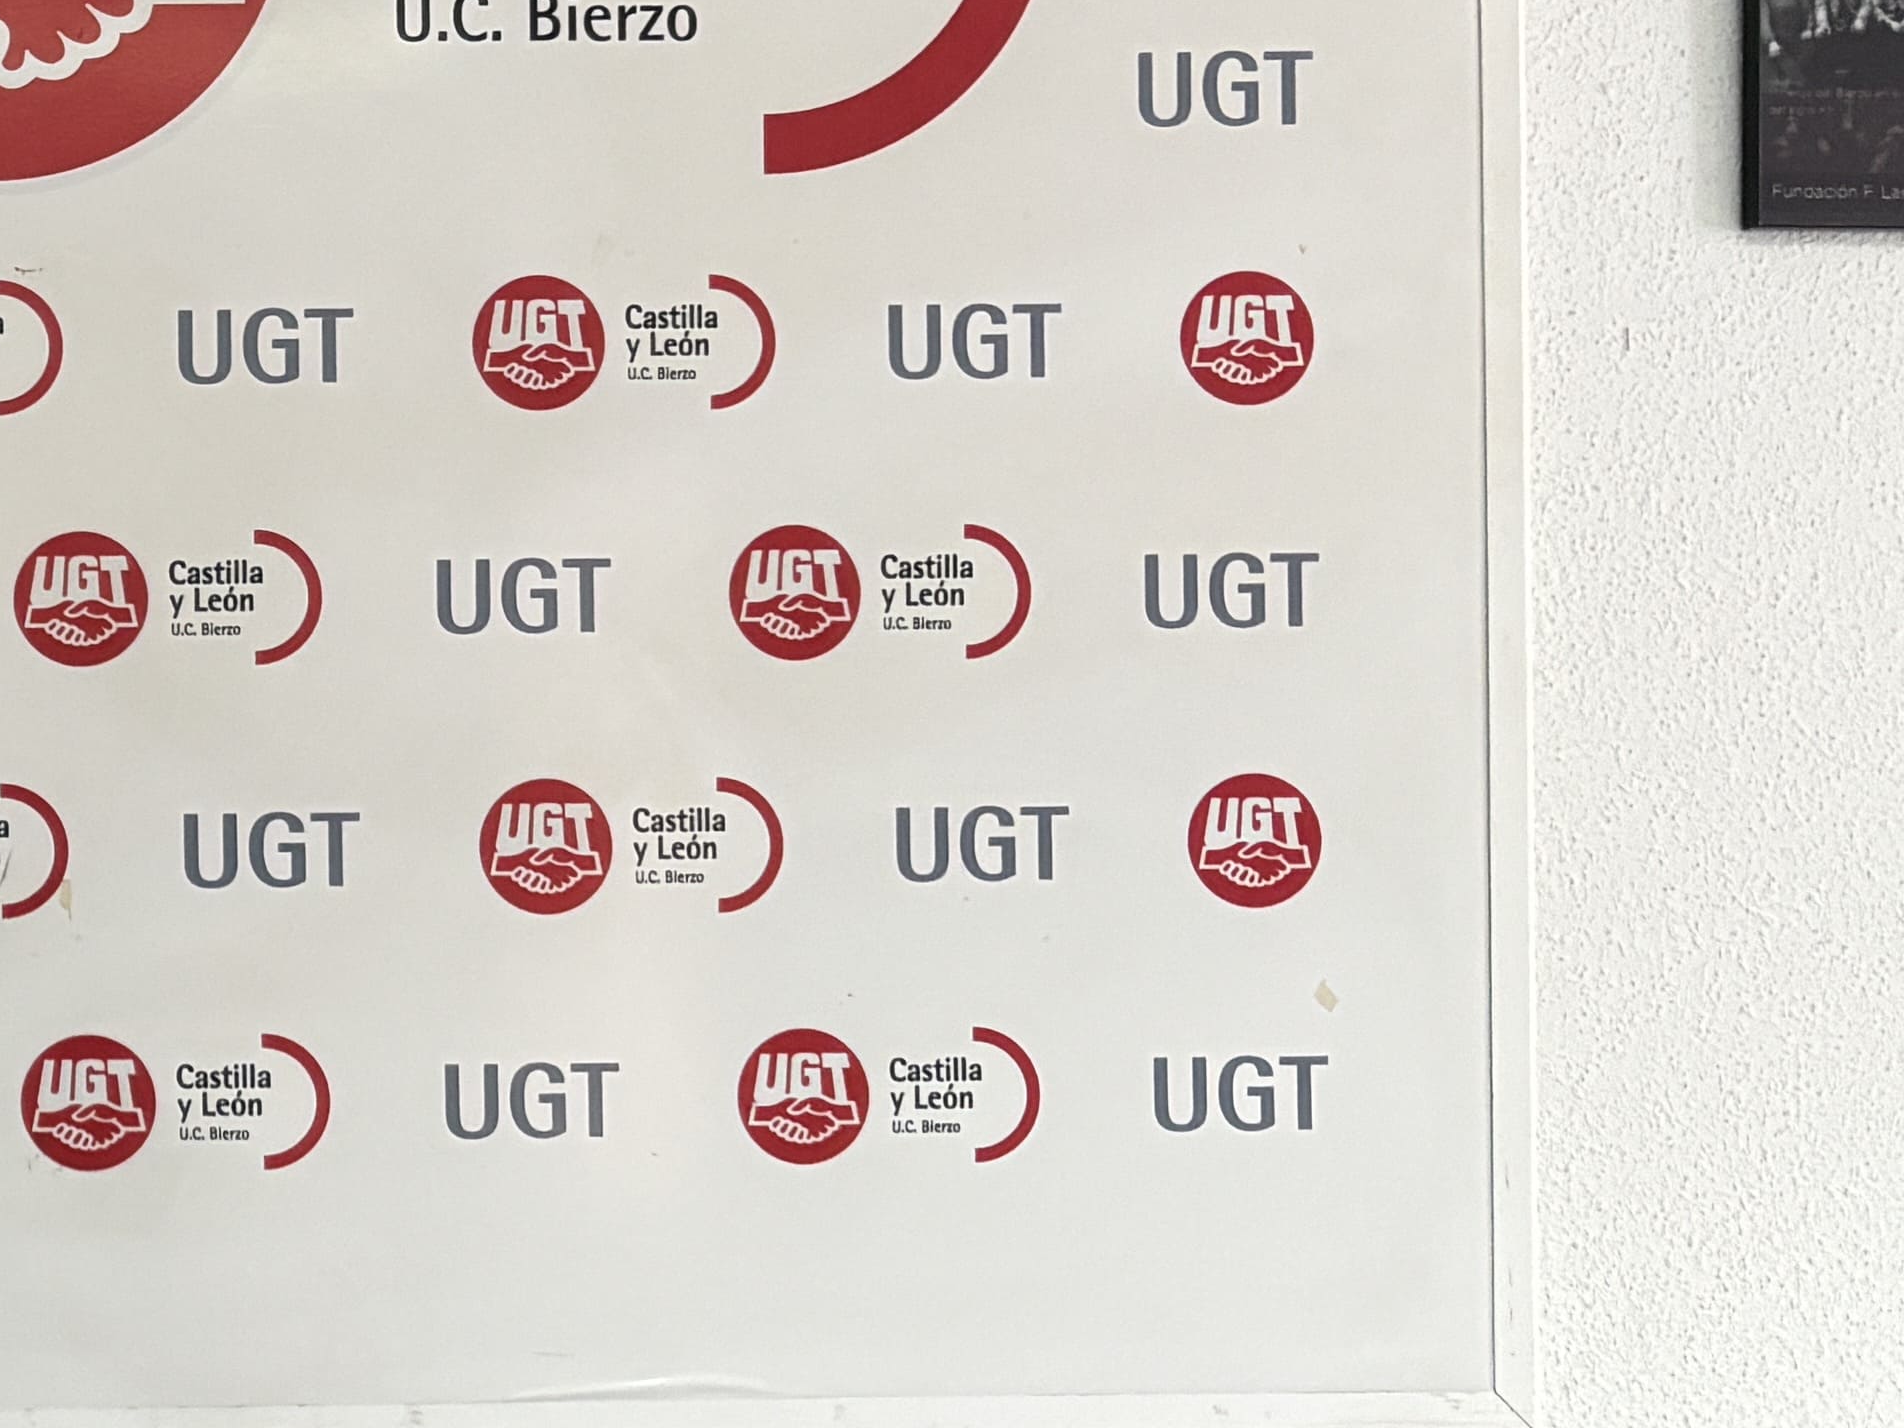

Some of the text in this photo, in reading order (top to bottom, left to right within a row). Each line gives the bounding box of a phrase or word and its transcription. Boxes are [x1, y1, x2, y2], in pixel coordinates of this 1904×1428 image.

[1138, 51, 1313, 127] UGT
[490, 299, 587, 348] UGT
[625, 304, 718, 329] Castilla
[1197, 295, 1296, 344] UGT
[178, 308, 353, 384] UGT
[626, 330, 709, 363] y León
[888, 304, 1061, 379] UGT
[628, 367, 696, 380] U.C. Bierzo
[31, 556, 129, 605] UGT
[169, 559, 263, 585] Castilla
[746, 549, 843, 598] UGT
[881, 553, 973, 579] Castilla
[170, 586, 254, 619] y León
[437, 558, 611, 634] UGT
[882, 580, 964, 613] y León
[1145, 553, 1319, 629] UGT
[171, 622, 241, 636] U.C. Bierzo
[883, 617, 951, 630] U.C. Bierzo
[497, 803, 594, 852] UGT
[633, 807, 725, 833] Castilla
[1205, 797, 1303, 846] UGT
[184, 812, 360, 888] UGT
[633, 834, 717, 867] y León
[896, 806, 1069, 882] UGT
[636, 870, 704, 884] U.C. Bierzo
[39, 1060, 137, 1109] UGT
[176, 1063, 271, 1089] Castilla
[754, 1053, 852, 1102] UGT
[889, 1057, 982, 1082] Castilla
[178, 1090, 262, 1124] y León
[445, 1063, 619, 1139] UGT
[890, 1083, 973, 1116] y León
[1154, 1056, 1328, 1132] UGT
[180, 1126, 249, 1140] U.C. Bierzo
[892, 1120, 960, 1133] U.C. Bierzo
